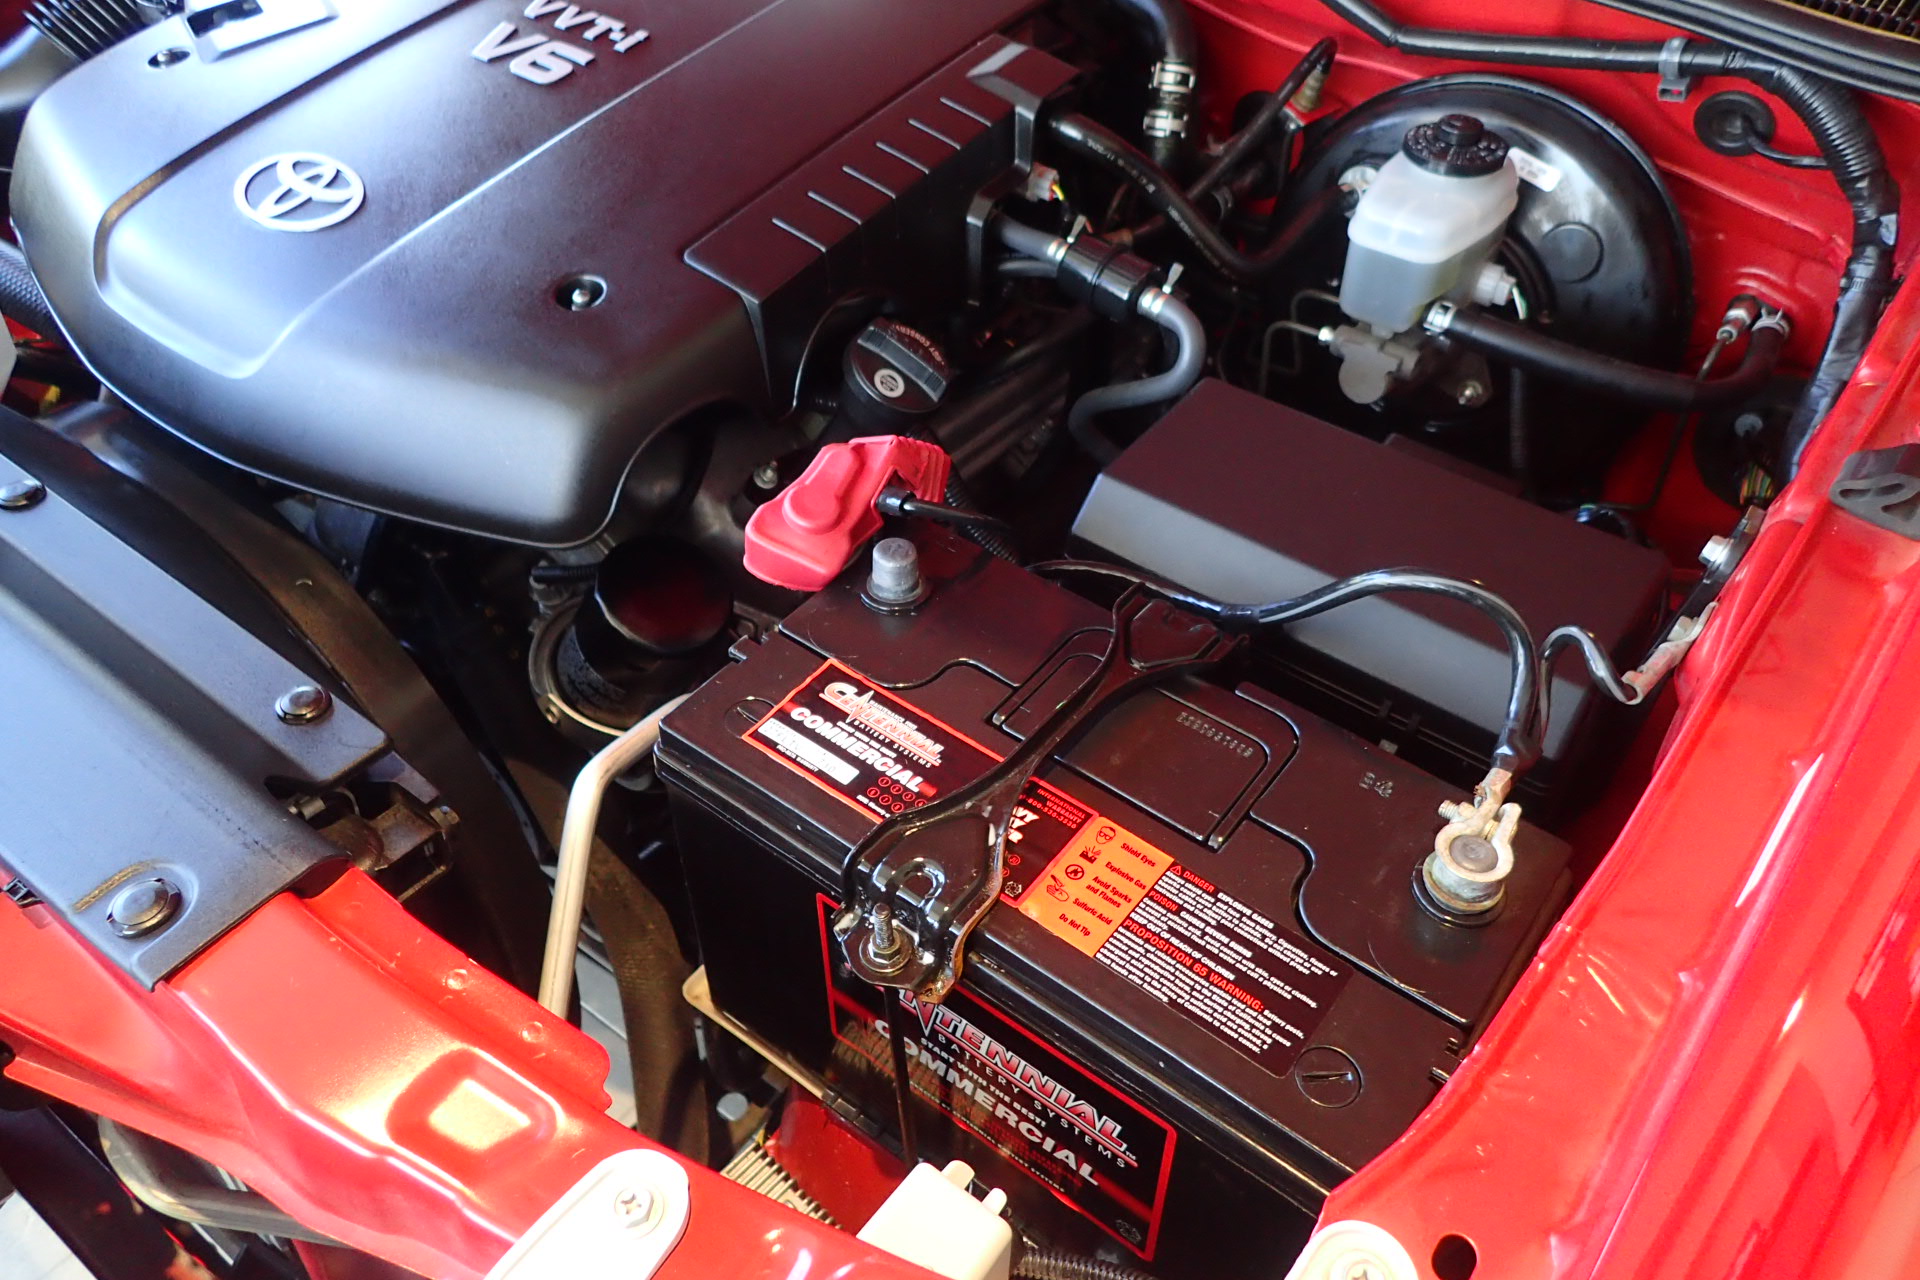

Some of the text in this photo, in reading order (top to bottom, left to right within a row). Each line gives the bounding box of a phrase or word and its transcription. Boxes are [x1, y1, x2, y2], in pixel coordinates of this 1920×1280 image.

[471, 20, 596, 85] V6
[790, 707, 926, 792] COMMERCIAL
[853, 720, 934, 768] BATTERY SYSTEMS
[1036, 788, 1086, 819] INTERNATIONAL
[1046, 800, 1082, 824] WARRANTY
[1105, 861, 1146, 890] Explosive Gas
[1120, 842, 1156, 867] Shield Eyes
[1072, 898, 1112, 926] Sulfuric Acid
[1086, 884, 1122, 908] and Flames
[1092, 876, 1132, 904] Avoid Sparks
[1149, 890, 1178, 911] POISON
[1180, 911, 1205, 929] CAUSES
[1204, 926, 1230, 944] SEVERE
[1183, 871, 1274, 929] DANGER EXPLOSIVE GASES
[1058, 913, 1091, 936] Do Not Tip
[1129, 912, 1148, 924] KEEP
[1146, 922, 1162, 934] OUT
[1169, 937, 1193, 954] REACH
[1201, 957, 1235, 980] CHILDREN
[1123, 919, 1193, 966] PROPOSITION
[1210, 973, 1263, 1011] WARNING:
[1263, 1009, 1286, 1027] Battery
[898, 988, 1128, 1152] NTENNIAL
[920, 1037, 1046, 1128] START WITH THE BEST!
[875, 1019, 1098, 1186] COMMERCIAL
[938, 1033, 1020, 1094] BATTERY
[1034, 1100, 1125, 1168] SYSTEMS
